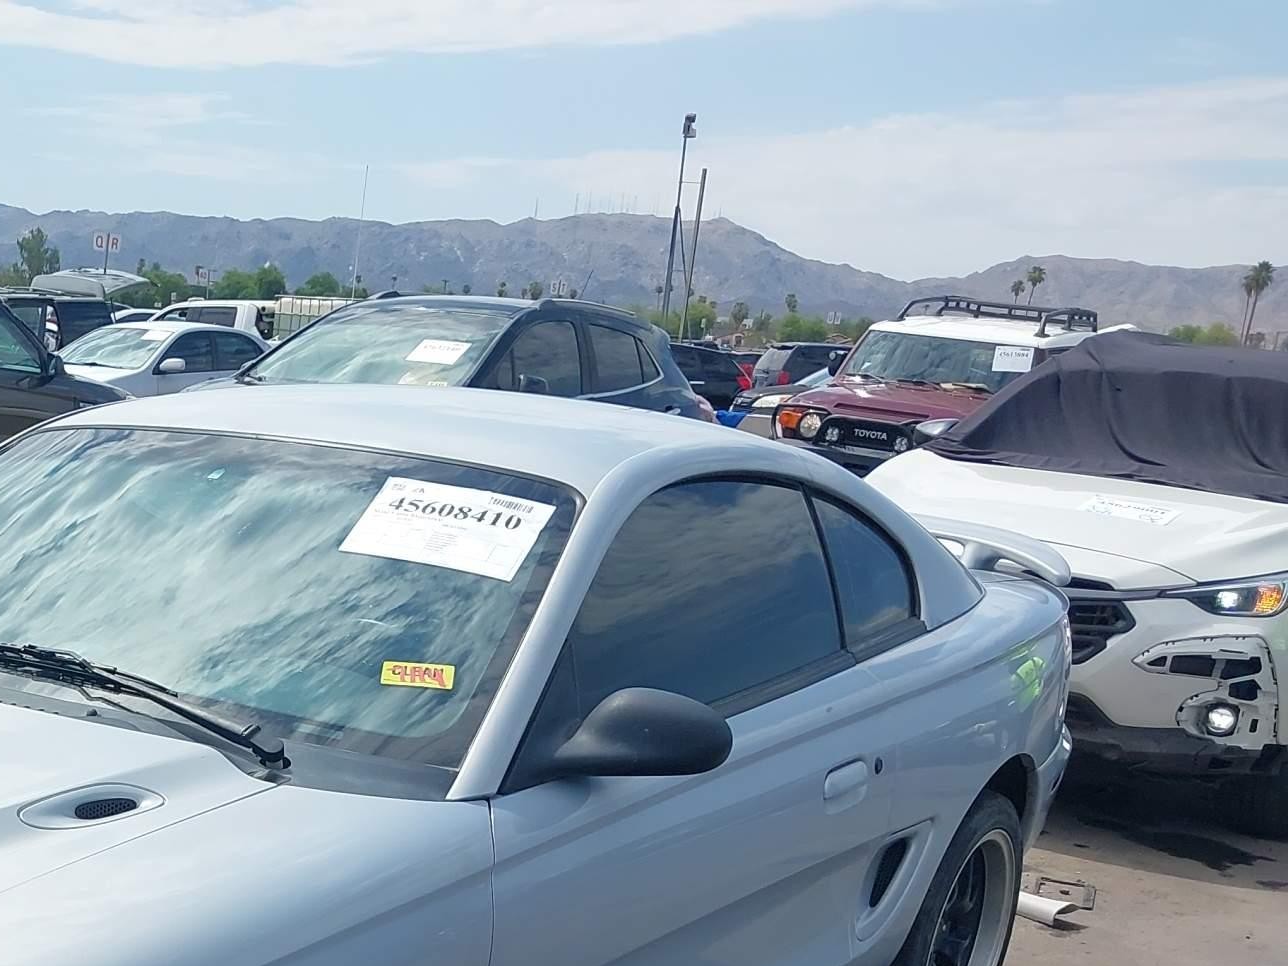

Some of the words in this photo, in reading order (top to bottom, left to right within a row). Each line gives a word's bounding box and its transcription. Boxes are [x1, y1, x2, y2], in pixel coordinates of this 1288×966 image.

[95, 235, 103, 248] Q
[111, 238, 119, 249] R
[854, 428, 888, 441] TOYOTA
[389, 497, 522, 530] 45608410
